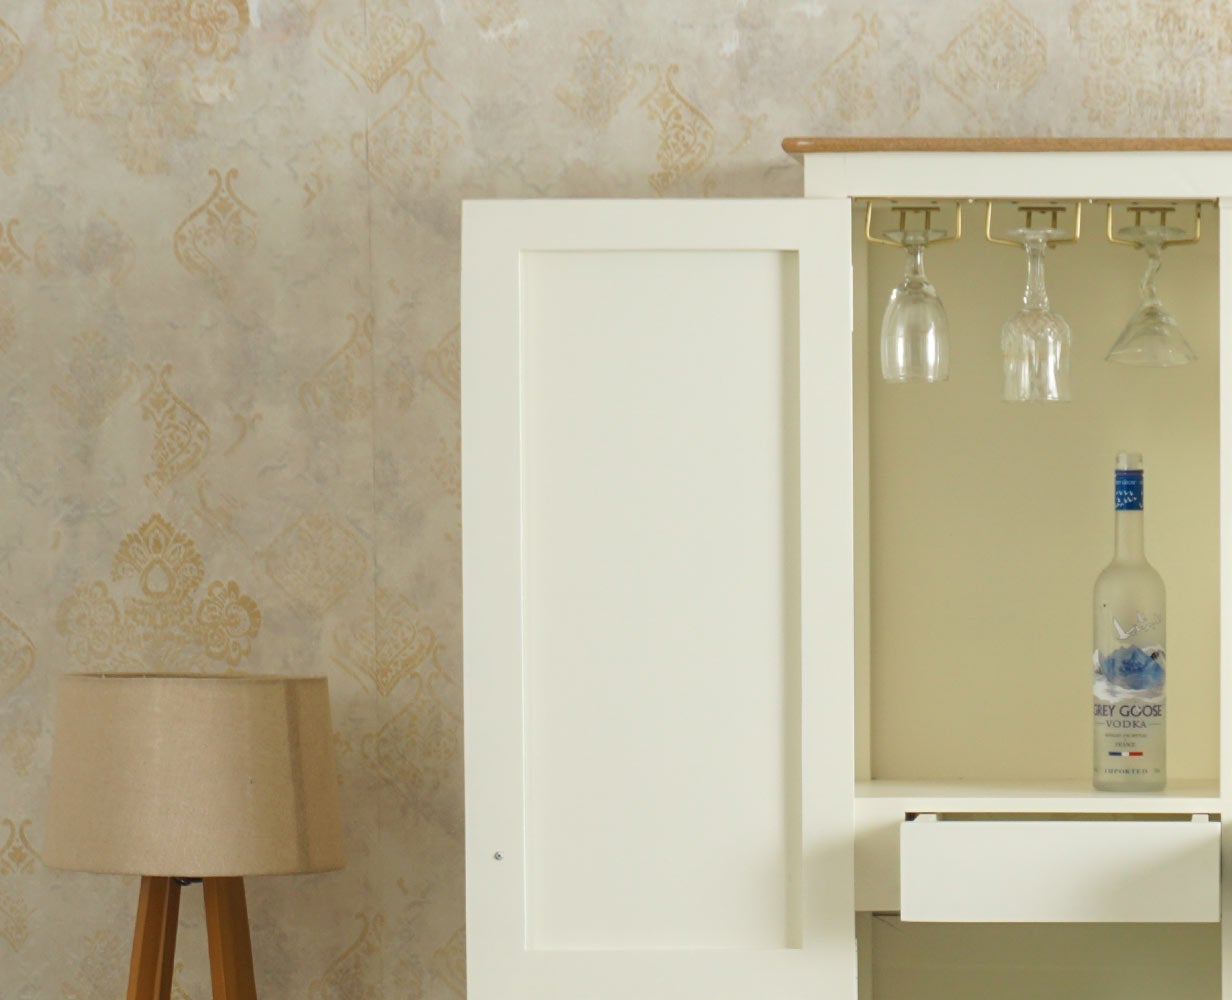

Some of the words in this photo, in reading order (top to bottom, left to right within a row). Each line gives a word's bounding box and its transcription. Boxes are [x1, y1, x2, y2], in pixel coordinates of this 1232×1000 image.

[1094, 704, 1115, 717] GREY
[1119, 705, 1162, 717] GOOSE
[1106, 719, 1147, 728] VODKA
